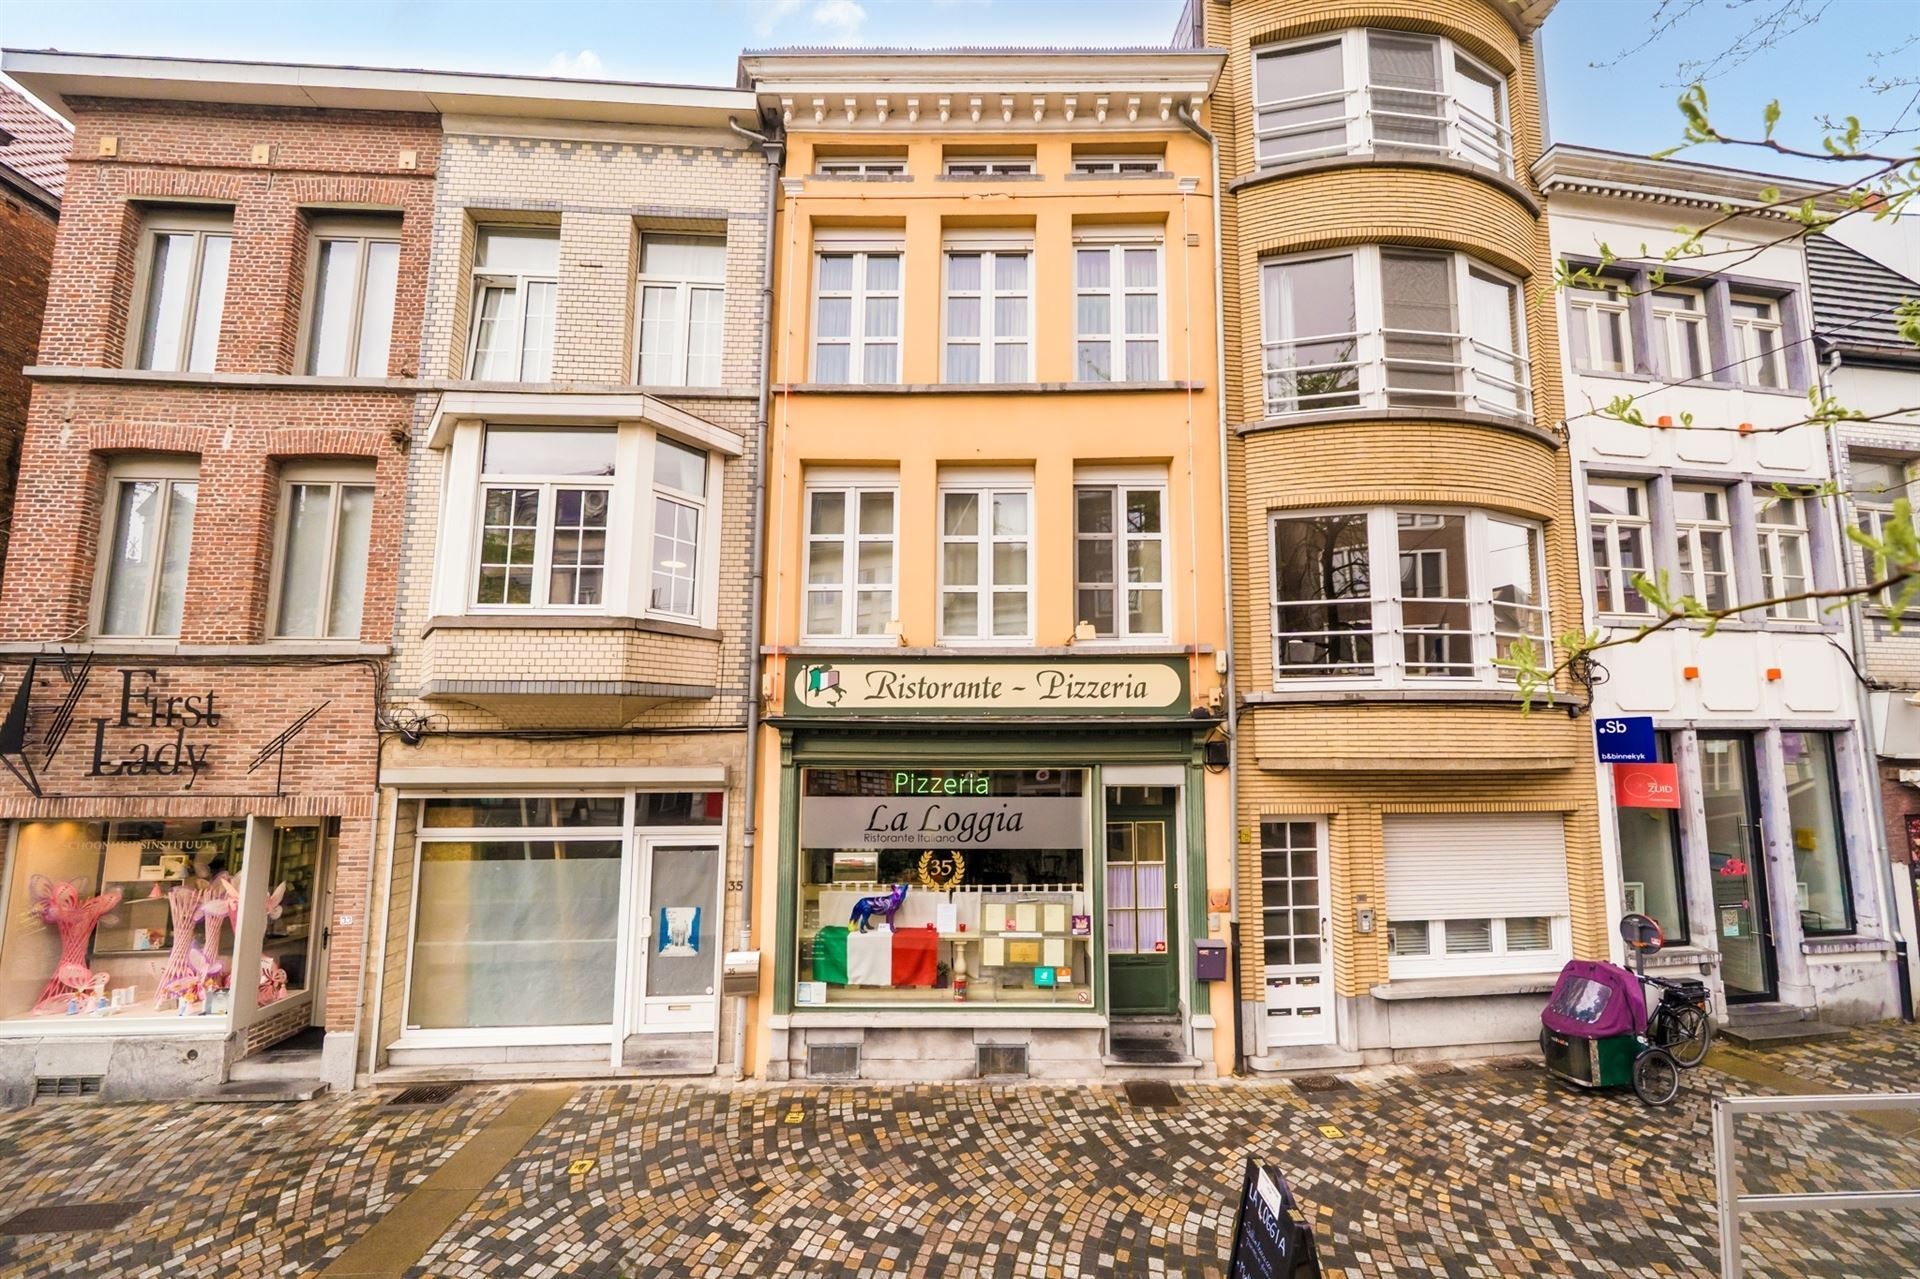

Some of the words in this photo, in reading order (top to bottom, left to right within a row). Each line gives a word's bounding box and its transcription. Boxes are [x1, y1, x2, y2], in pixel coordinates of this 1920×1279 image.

[864, 670, 1002, 700] Ristorante
[1036, 670, 1149, 700] Pizzeria
[110, 669, 220, 728] First
[1599, 720, 1627, 734] .Sb
[84, 717, 212, 790] Lady
[1601, 752, 1646, 760] b&binnekyk
[895, 772, 990, 795] Pizzeria
[865, 804, 909, 832] La
[918, 803, 1024, 843] Loggia
[863, 833, 915, 843] Ristorante
[917, 833, 957, 843] Italiano
[930, 859, 954, 876] 35
[728, 880, 744, 891] 35
[1258, 1198, 1286, 1257] LOGGIA
